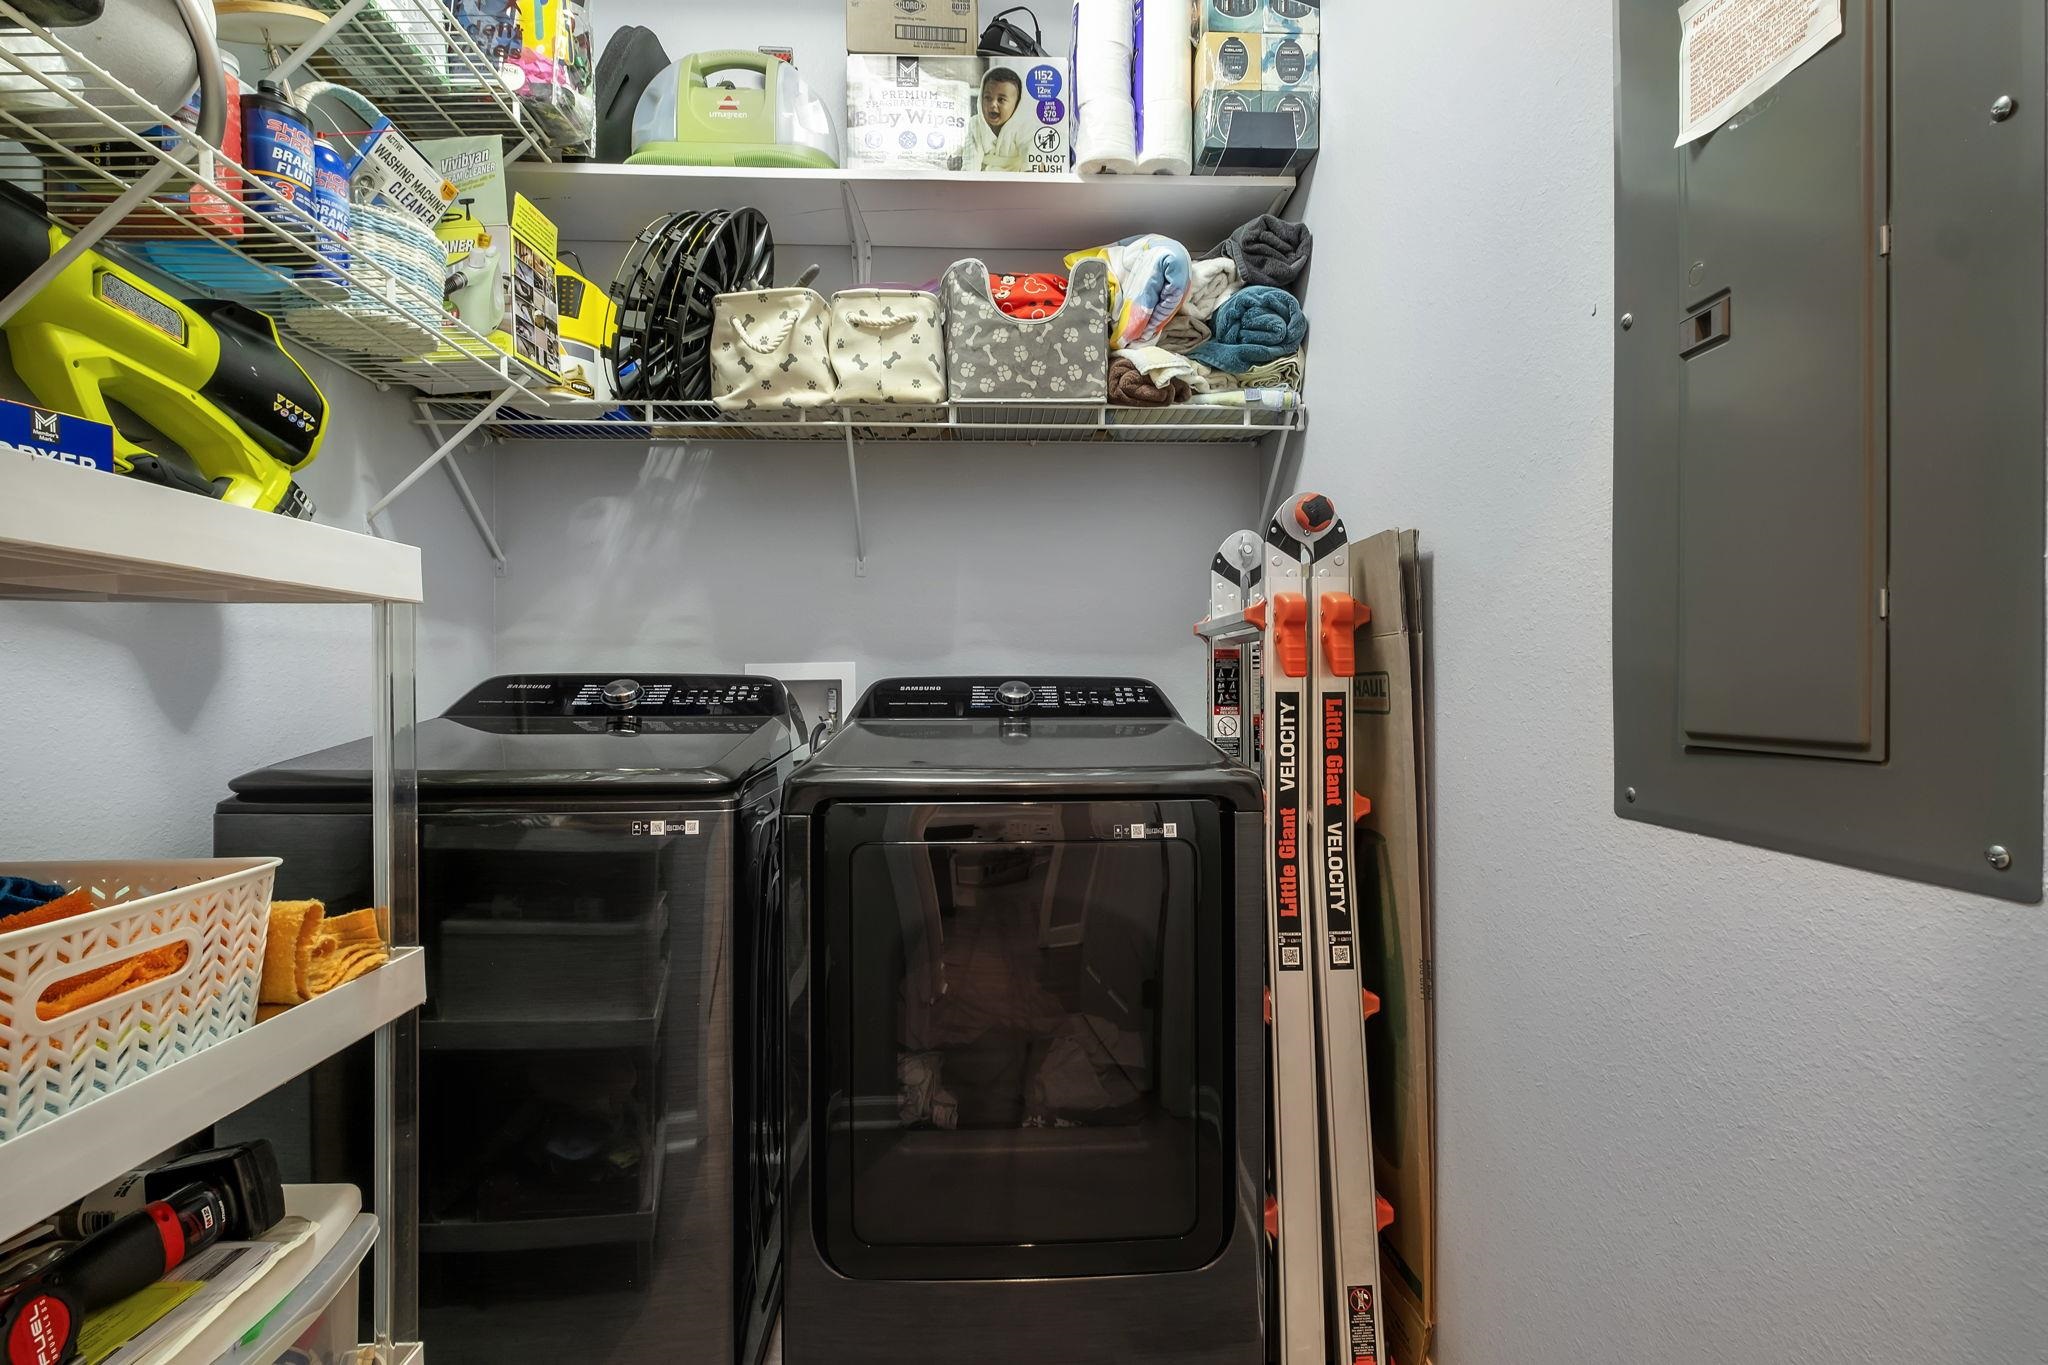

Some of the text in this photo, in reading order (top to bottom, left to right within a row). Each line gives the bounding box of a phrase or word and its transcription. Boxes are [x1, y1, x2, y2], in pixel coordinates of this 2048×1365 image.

[1034, 70, 1053, 80] 1152
[882, 90, 938, 100] PREMIUM
[856, 108, 965, 128] Baby Wipes
[386, 134, 405, 153] ACTIVE
[272, 146, 315, 177] BRAKE
[441, 149, 489, 174] Vivibyan
[1028, 154, 1066, 163] DO NOT
[1032, 165, 1063, 173] FLUSH
[276, 161, 313, 188] FLUID
[374, 143, 415, 184] WASHING
[411, 179, 446, 215] MACHINE
[275, 181, 295, 201] 3
[388, 181, 436, 227] CLEANER
[443, 239, 475, 254] ANER
[1354, 679, 1386, 697] HAUL
[1325, 698, 1343, 749] Little
[1280, 701, 1296, 793] VELOCITY
[1325, 755, 1344, 807] Giant
[1278, 807, 1297, 860] Giant
[1327, 822, 1346, 914] VELOCITY
[1279, 864, 1298, 917] Little
[203, 1207, 212, 1227] M12
